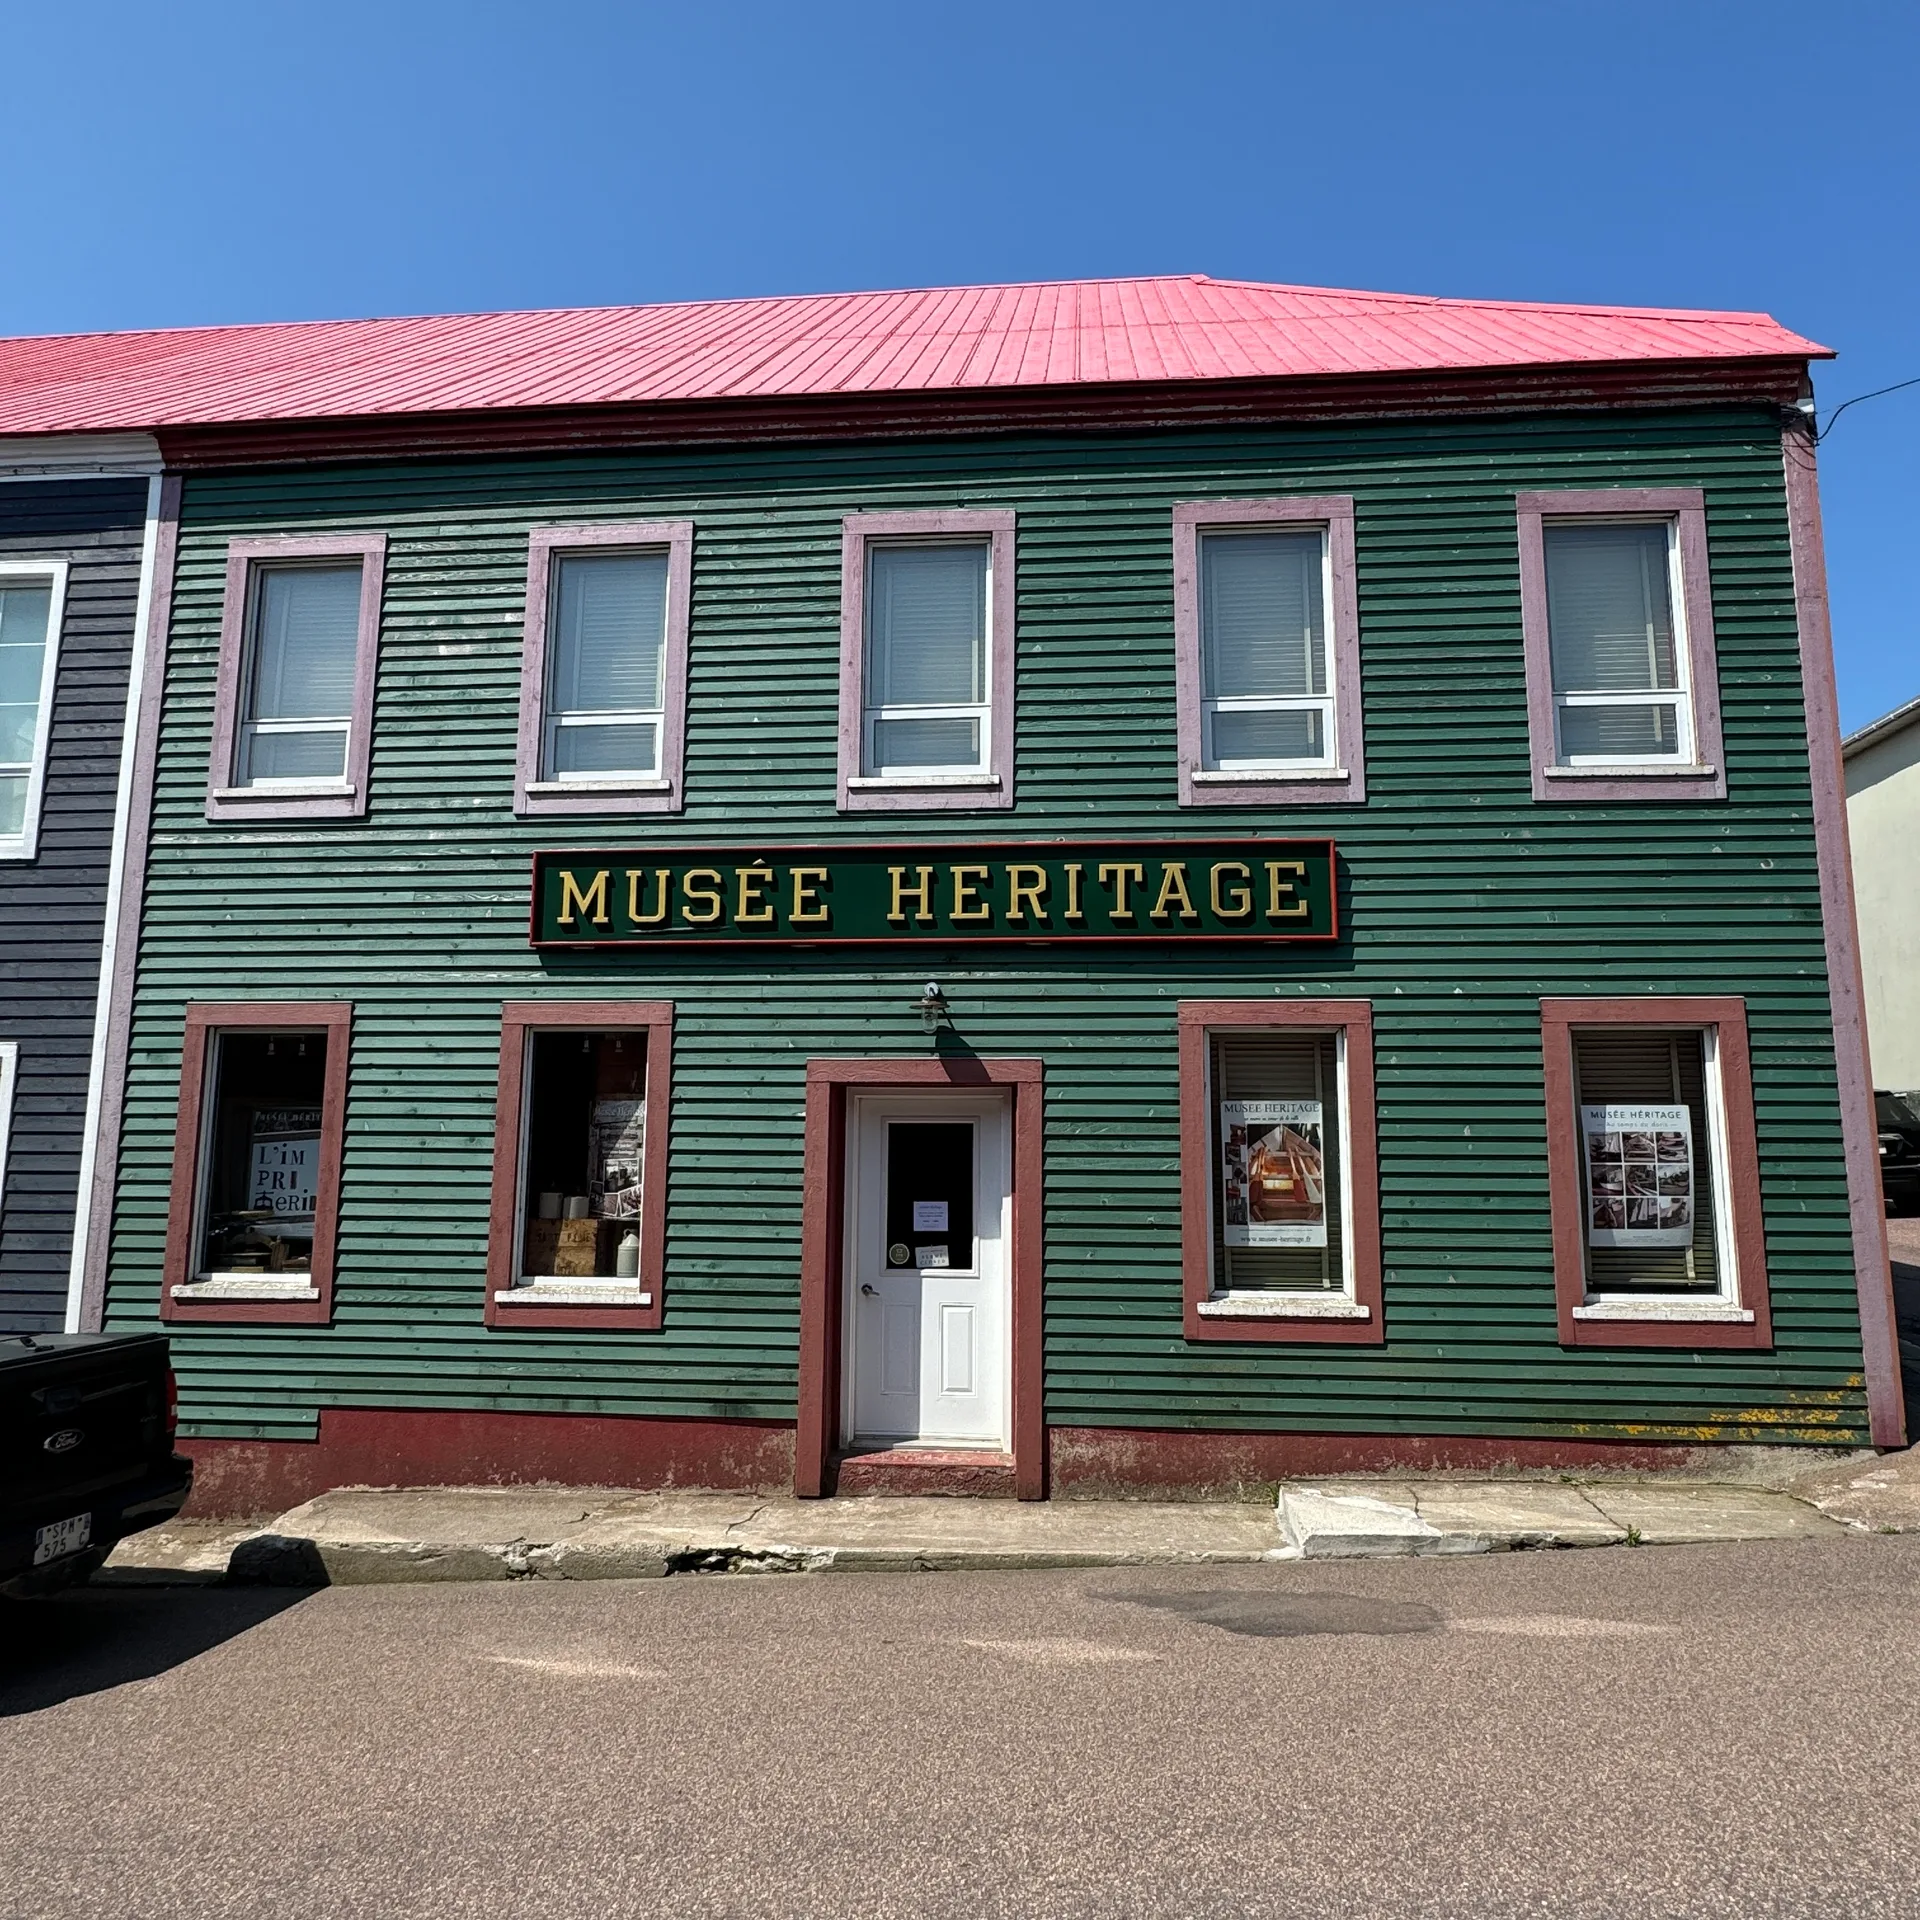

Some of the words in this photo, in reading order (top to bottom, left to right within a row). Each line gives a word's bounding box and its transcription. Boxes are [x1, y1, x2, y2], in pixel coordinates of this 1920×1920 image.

[557, 858, 828, 924] MUSÉE
[886, 862, 1308, 921] HERITAGE
[1590, 1109, 1625, 1119] MUSÉE
[1629, 1109, 1682, 1119] HÉRITAGE
[257, 1170, 297, 1190] PRI
[52, 1518, 75, 1539] SPM
[43, 1536, 67, 1558] 575
[78, 1530, 86, 1546] C
